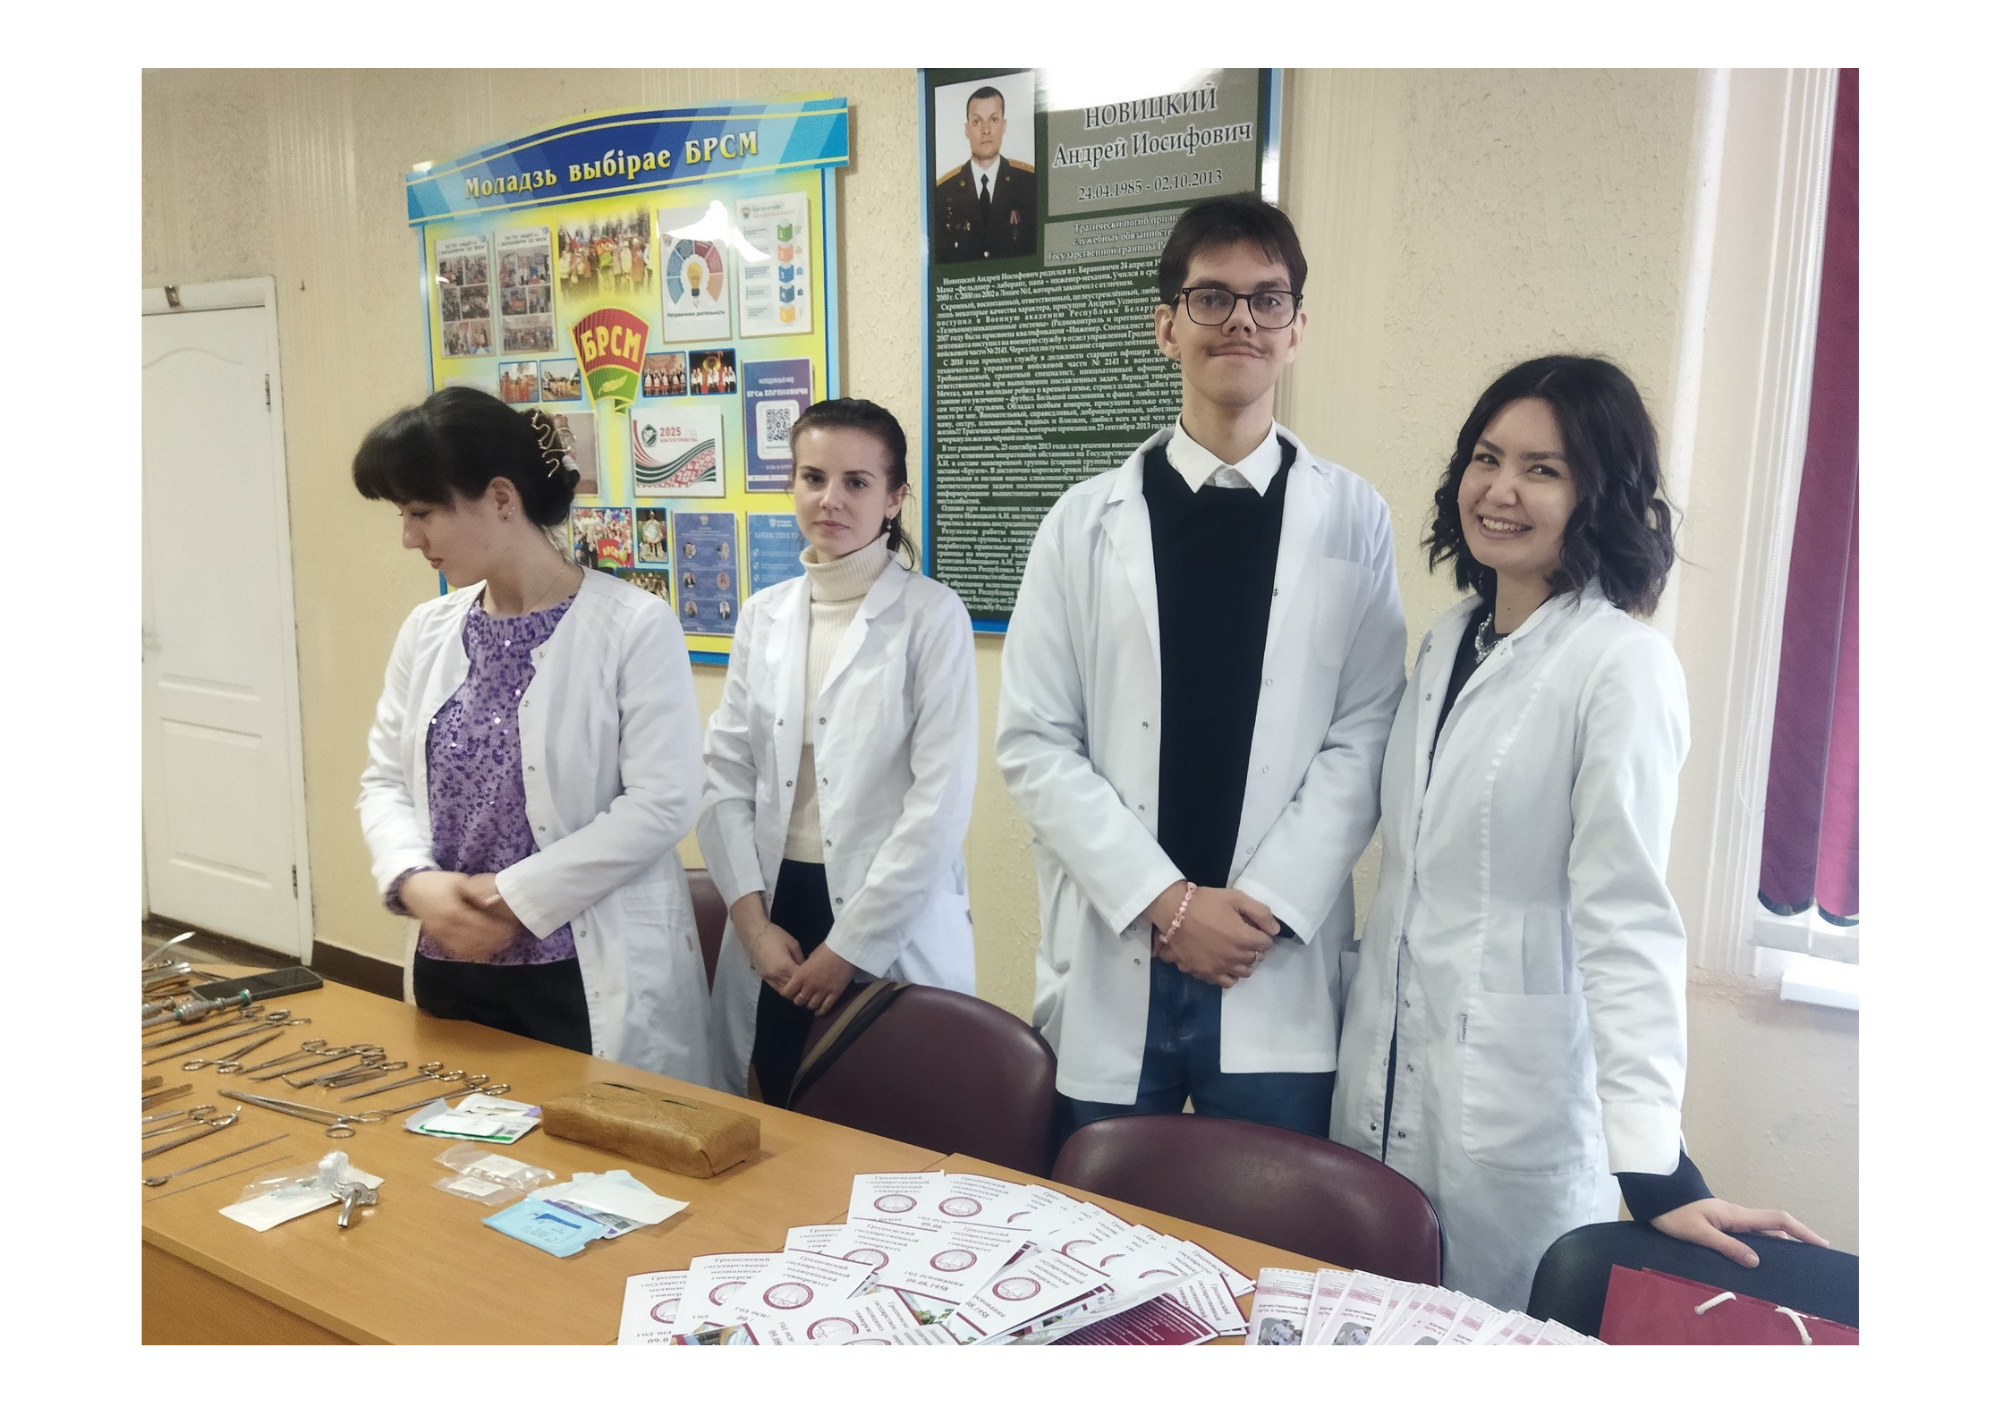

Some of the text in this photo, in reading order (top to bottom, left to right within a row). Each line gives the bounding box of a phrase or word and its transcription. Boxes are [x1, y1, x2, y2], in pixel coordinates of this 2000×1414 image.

[1085, 82, 1217, 129] НОВИЦКИЙ
[1053, 124, 1252, 168] Андрей Иосифович
[465, 130, 758, 199] Моладзь выбірае БРСМ
[1078, 180, 1142, 201] 24.04.1985
[1154, 170, 1223, 192] 02.10.2013
[1121, 228, 1173, 242] обязанносте
[1070, 308, 1119, 316] Республики
[1125, 305, 1157, 313] Беларус
[580, 325, 642, 364] БРСМ
[660, 426, 681, 437] 2025
